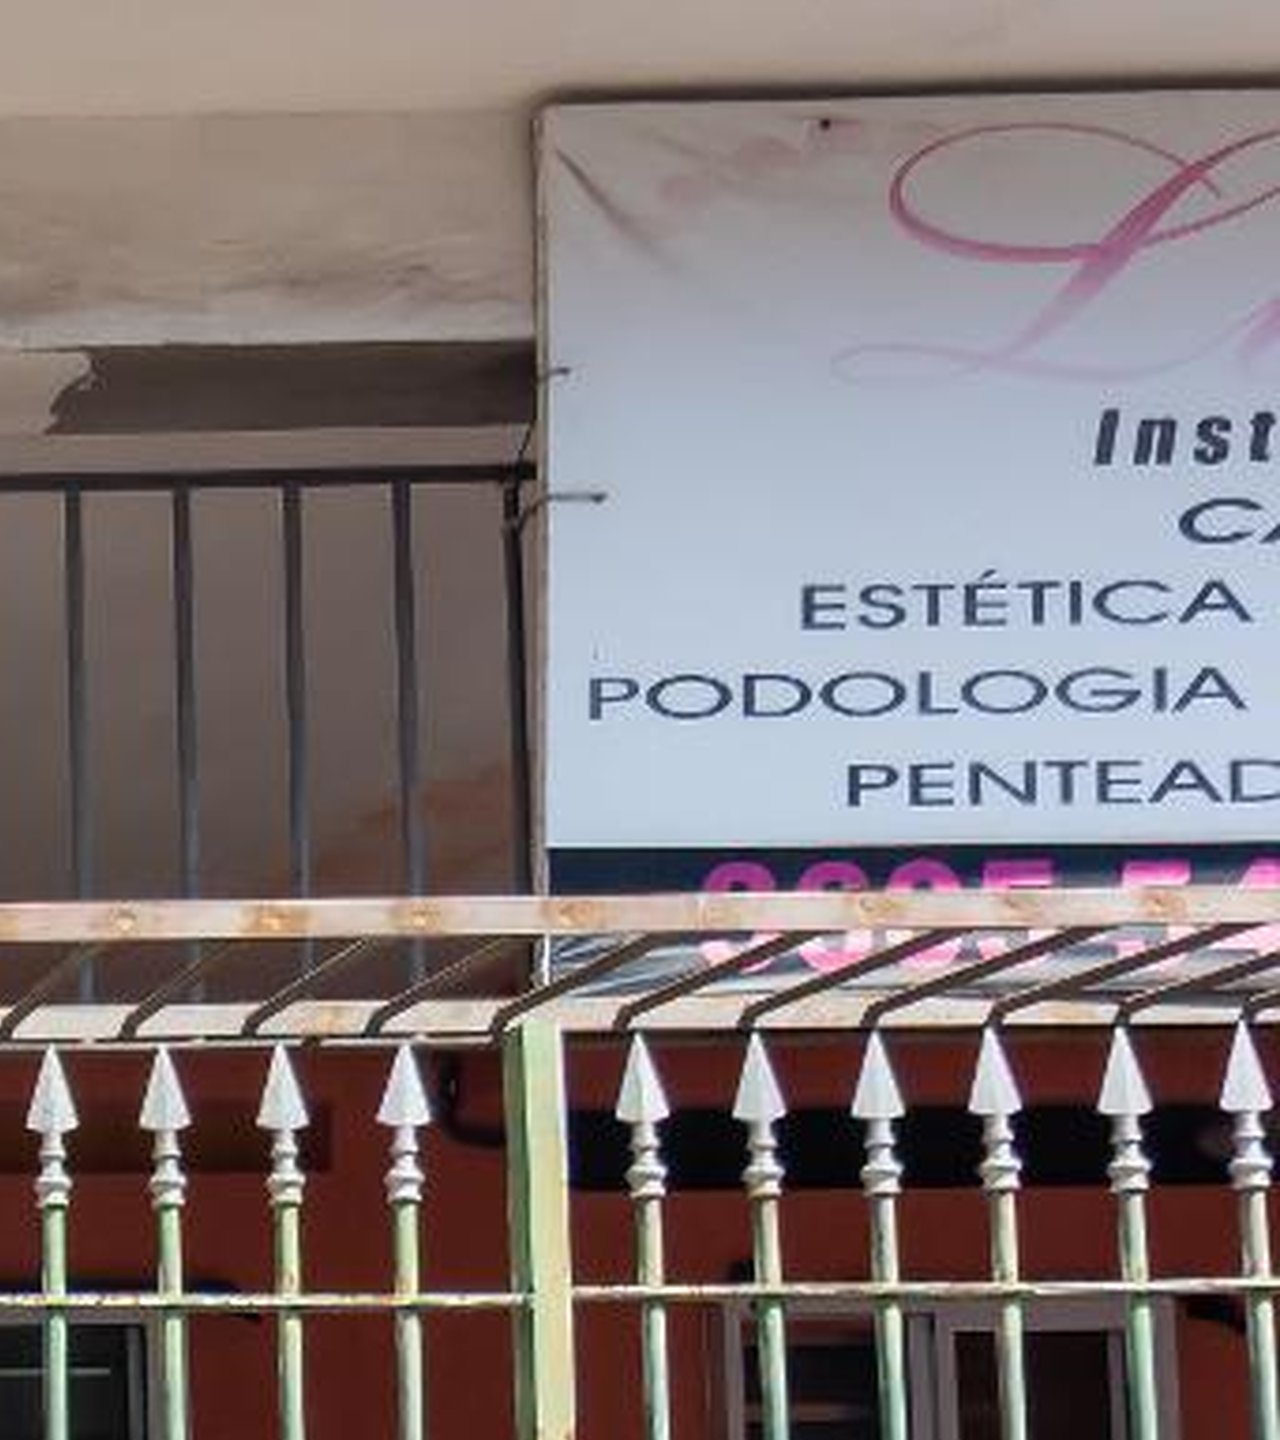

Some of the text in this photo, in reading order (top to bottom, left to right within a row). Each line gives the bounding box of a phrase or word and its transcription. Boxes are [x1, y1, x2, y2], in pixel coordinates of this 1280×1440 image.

[1094, 408, 1277, 466] Inst
[800, 568, 1253, 632] ESTÉTICA
[589, 666, 1247, 721] PODOLOGIA
